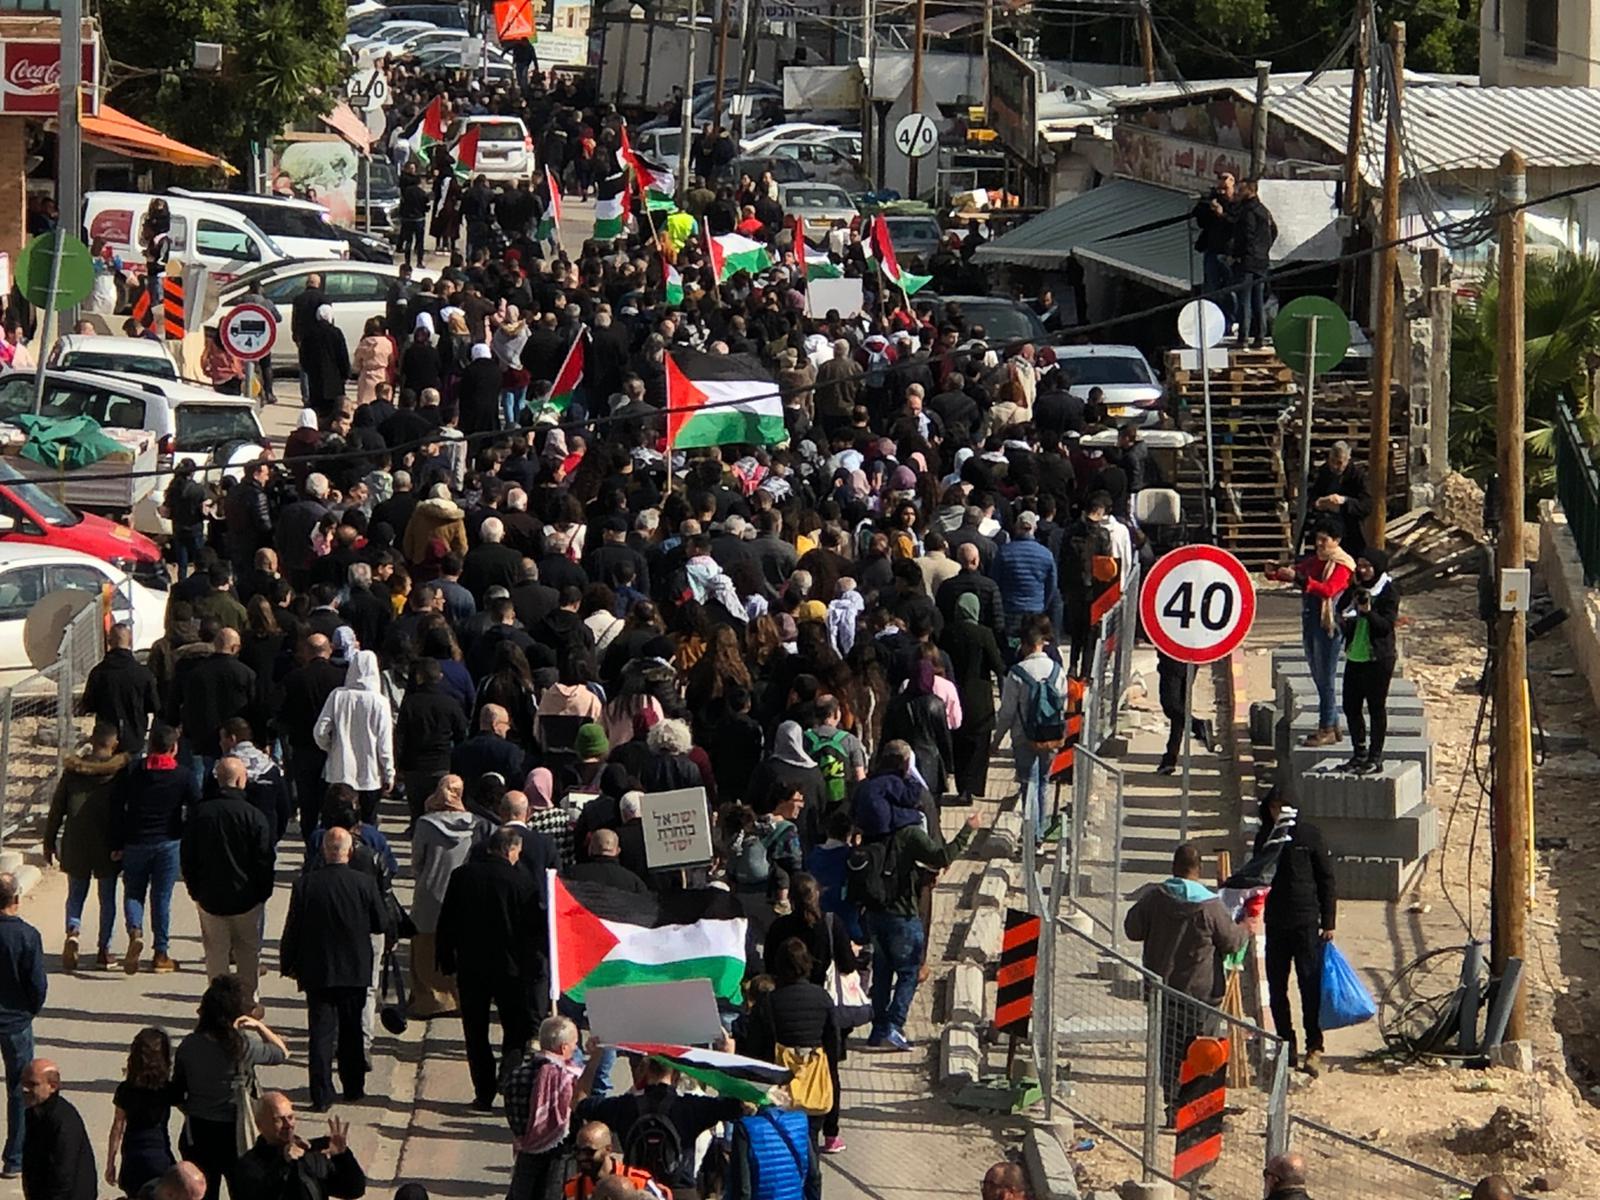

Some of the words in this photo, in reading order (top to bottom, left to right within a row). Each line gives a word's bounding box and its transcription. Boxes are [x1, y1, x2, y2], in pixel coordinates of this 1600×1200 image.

[244, 337, 253, 348] 4
[1163, 581, 1234, 632] 40
[652, 809, 697, 827] ישראל
[656, 824, 696, 842] בוחרת
